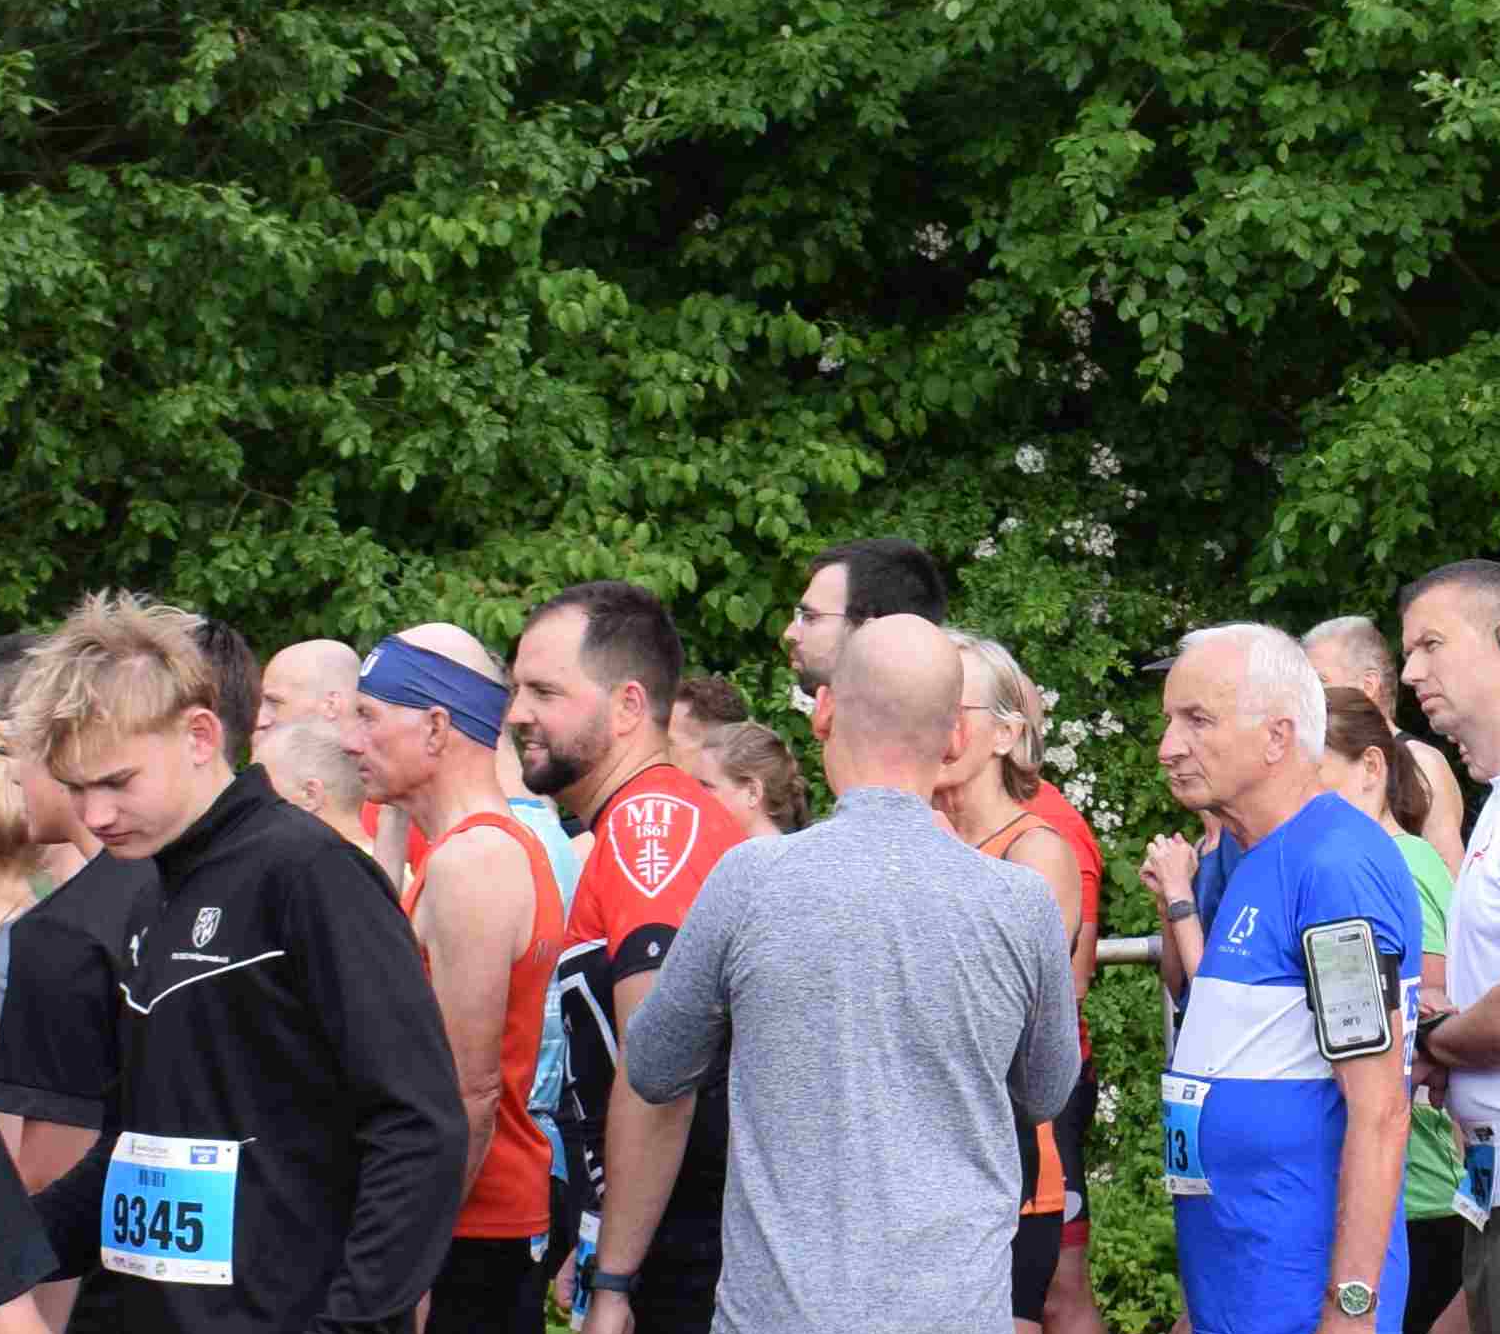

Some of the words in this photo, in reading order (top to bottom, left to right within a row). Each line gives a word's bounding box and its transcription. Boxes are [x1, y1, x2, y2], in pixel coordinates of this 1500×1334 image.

[626, 799, 679, 827] MT
[635, 824, 669, 839] 1861
[1163, 1129, 1190, 1172] 13
[113, 1193, 205, 1254] 9345
